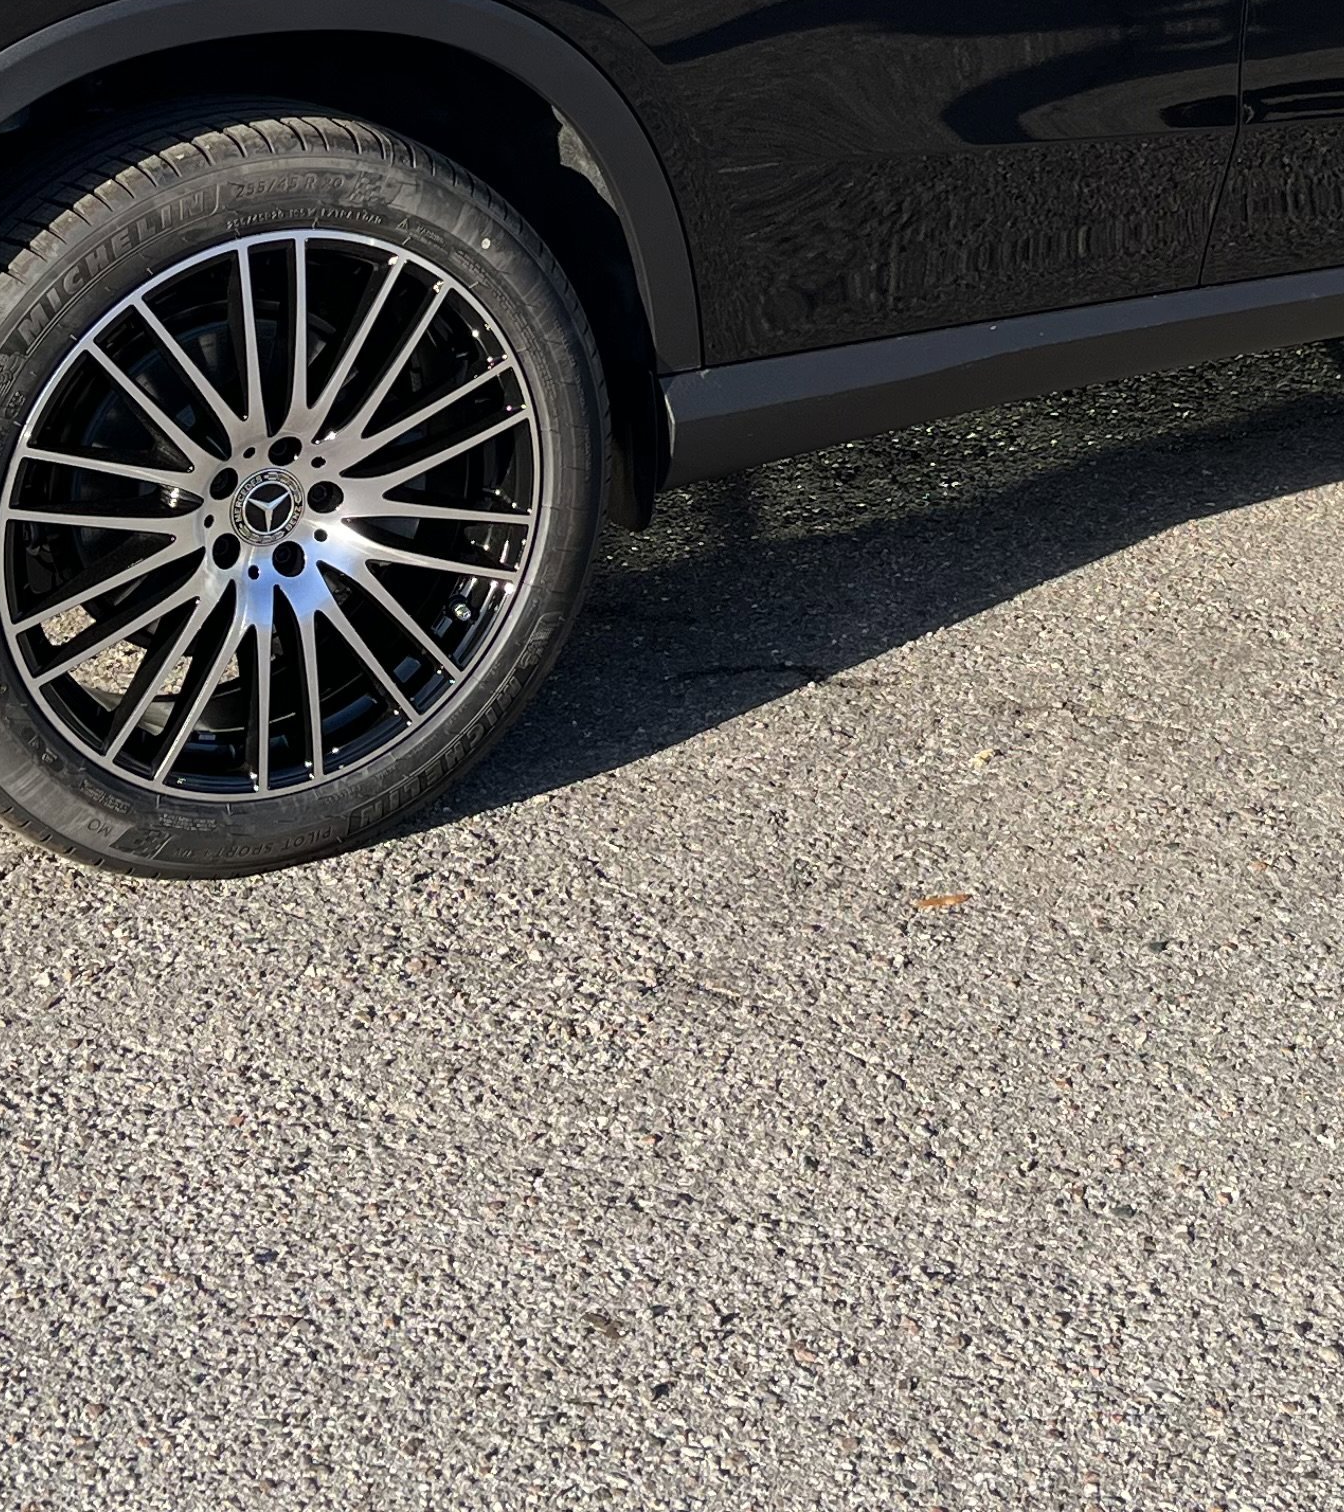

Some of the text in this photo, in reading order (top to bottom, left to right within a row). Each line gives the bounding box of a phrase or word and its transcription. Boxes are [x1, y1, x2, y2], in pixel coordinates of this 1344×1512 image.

[306, 174, 318, 190] R
[16, 192, 208, 347] MICHELIN
[234, 475, 263, 523] MERCEDES
[285, 506, 304, 531] BENZ
[359, 675, 524, 828] MICHELIN
[216, 842, 274, 858] SPORT
[280, 825, 333, 850] PILOT
